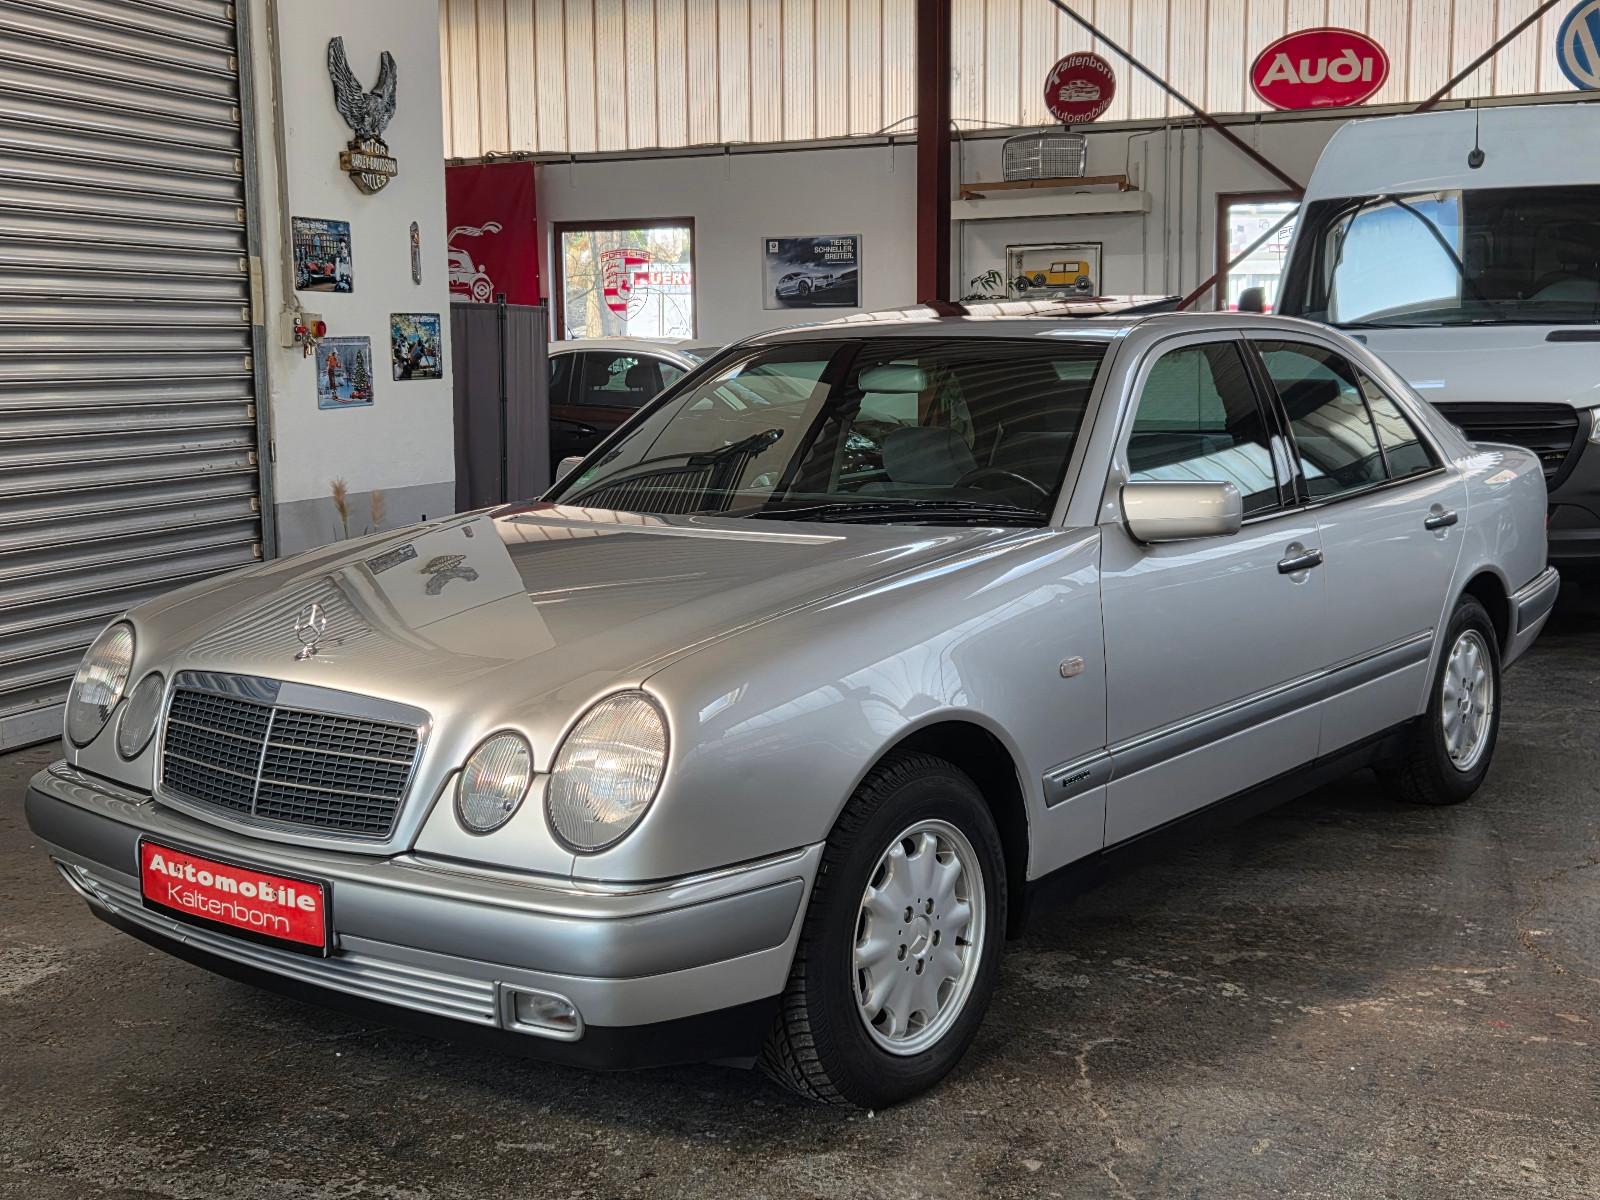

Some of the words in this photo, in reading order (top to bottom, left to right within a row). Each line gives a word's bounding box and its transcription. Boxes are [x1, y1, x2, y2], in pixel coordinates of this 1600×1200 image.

[1259, 49, 1374, 87] Audi
[361, 139, 386, 155] MOTOR
[361, 172, 387, 190] CYCLES
[814, 246, 854, 254] SCHNELLER.
[830, 239, 854, 247] TIEFER.
[601, 250, 650, 260] PORSCHE
[824, 252, 854, 260] BREITER.
[149, 854, 316, 912] Automobile
[167, 882, 290, 933] Kaltenborn
